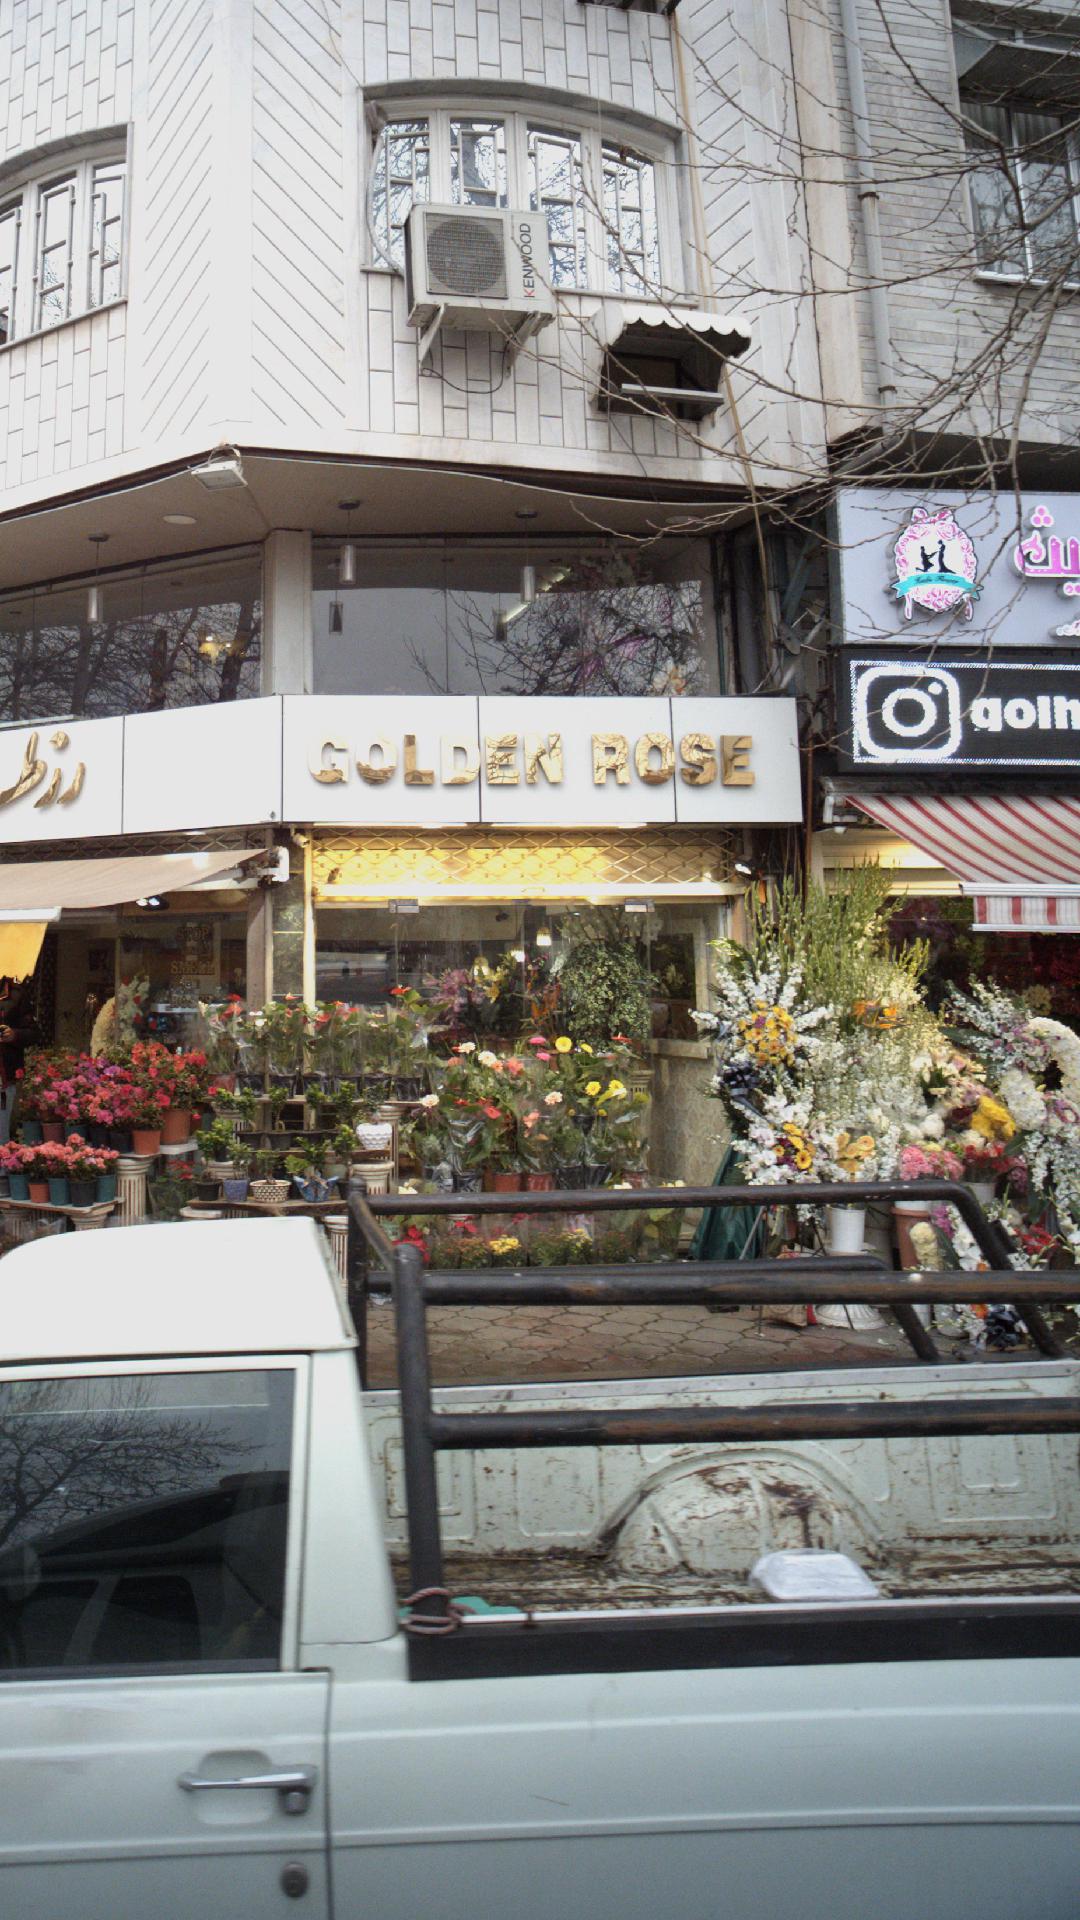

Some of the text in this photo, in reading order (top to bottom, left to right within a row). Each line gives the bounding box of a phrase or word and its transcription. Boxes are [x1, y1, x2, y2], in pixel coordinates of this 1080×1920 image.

[520, 223, 535, 298] KENWOOD
[307, 732, 756, 786] GOLDEN ROSE
